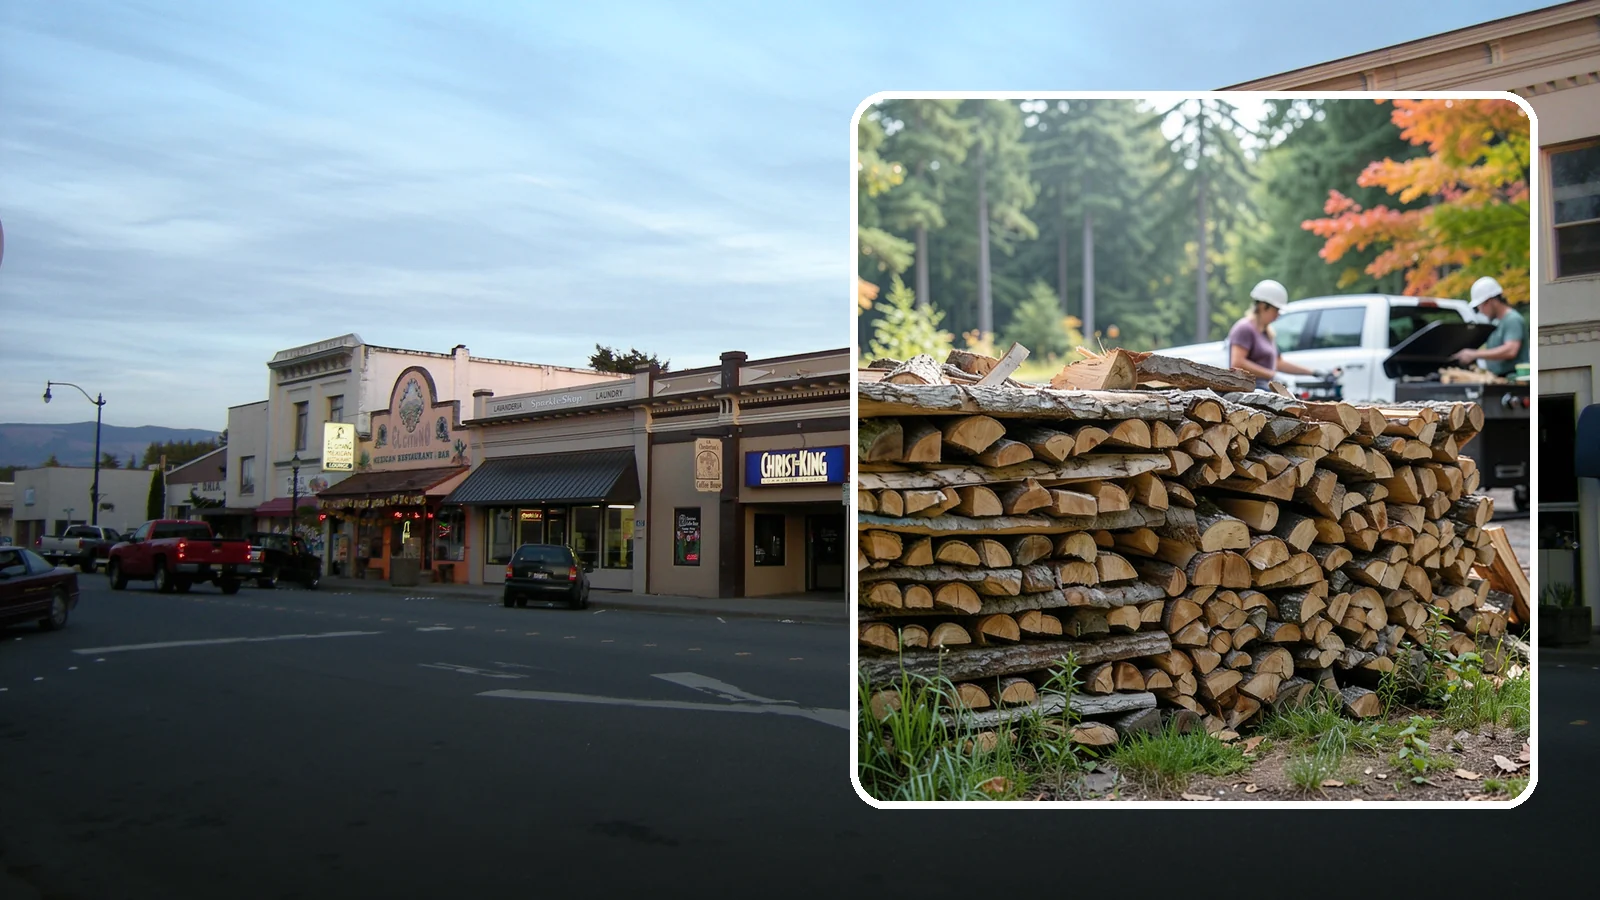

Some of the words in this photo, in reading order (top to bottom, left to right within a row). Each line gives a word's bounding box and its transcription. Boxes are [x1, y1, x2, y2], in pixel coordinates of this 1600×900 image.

[494, 402, 522, 412] LAVANDERIA
[531, 398, 560, 409] Sparkle
[560, 394, 583, 406] Shop
[595, 389, 623, 400] LAUNDRY
[373, 455, 396, 464] MEXICAN
[398, 451, 433, 462] RESTAURANT
[438, 450, 449, 459] BAR
[761, 452, 797, 477] CHRIST
[799, 450, 827, 476] KING
